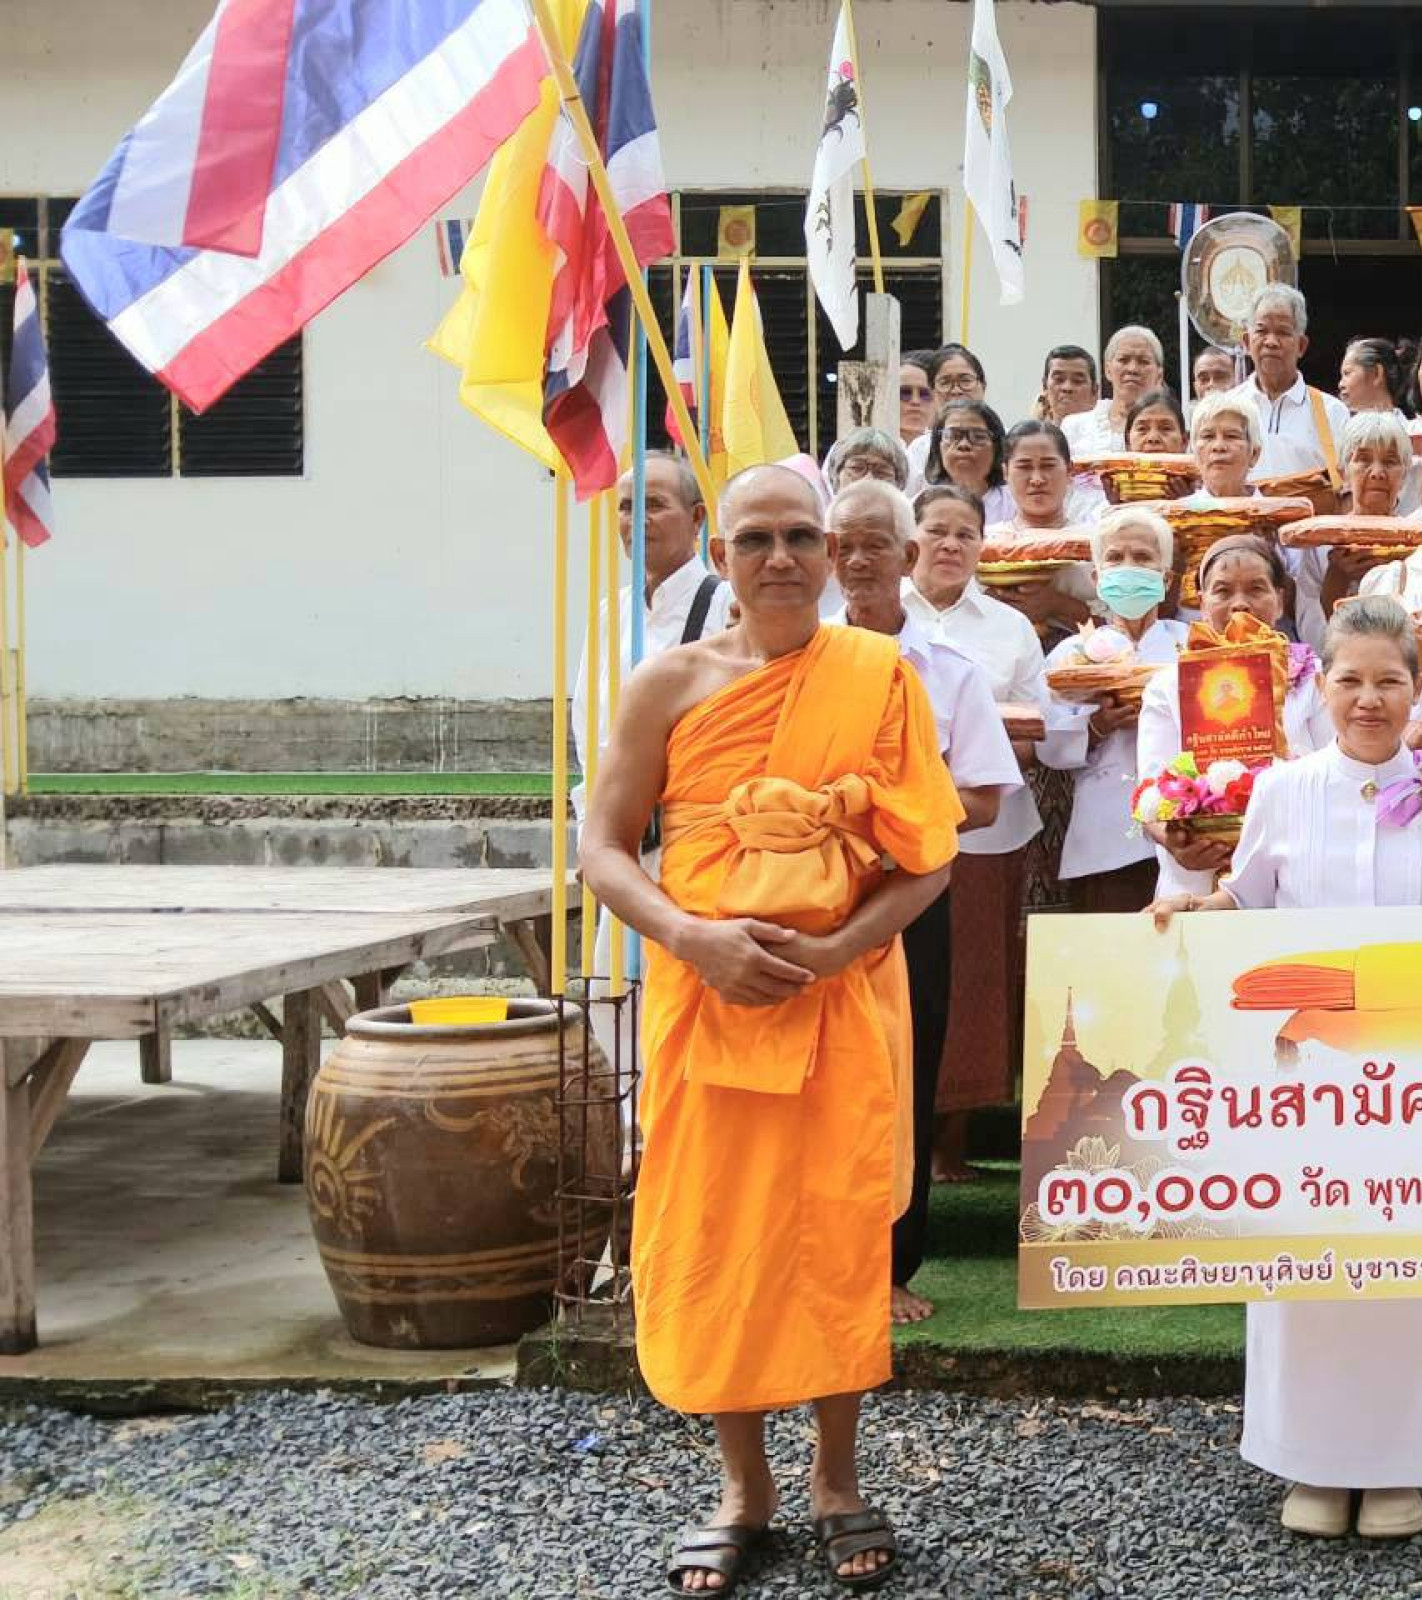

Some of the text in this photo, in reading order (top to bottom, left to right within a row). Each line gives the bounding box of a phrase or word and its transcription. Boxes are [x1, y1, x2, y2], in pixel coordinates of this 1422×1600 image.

[1047, 1173, 1282, 1222] ๓๐,๐๐๐
[1300, 1166, 1350, 1207] วัด
[1053, 1261, 1104, 1288] โดย
[1117, 1252, 1333, 1292] คณะศิษยานุศิษย์
